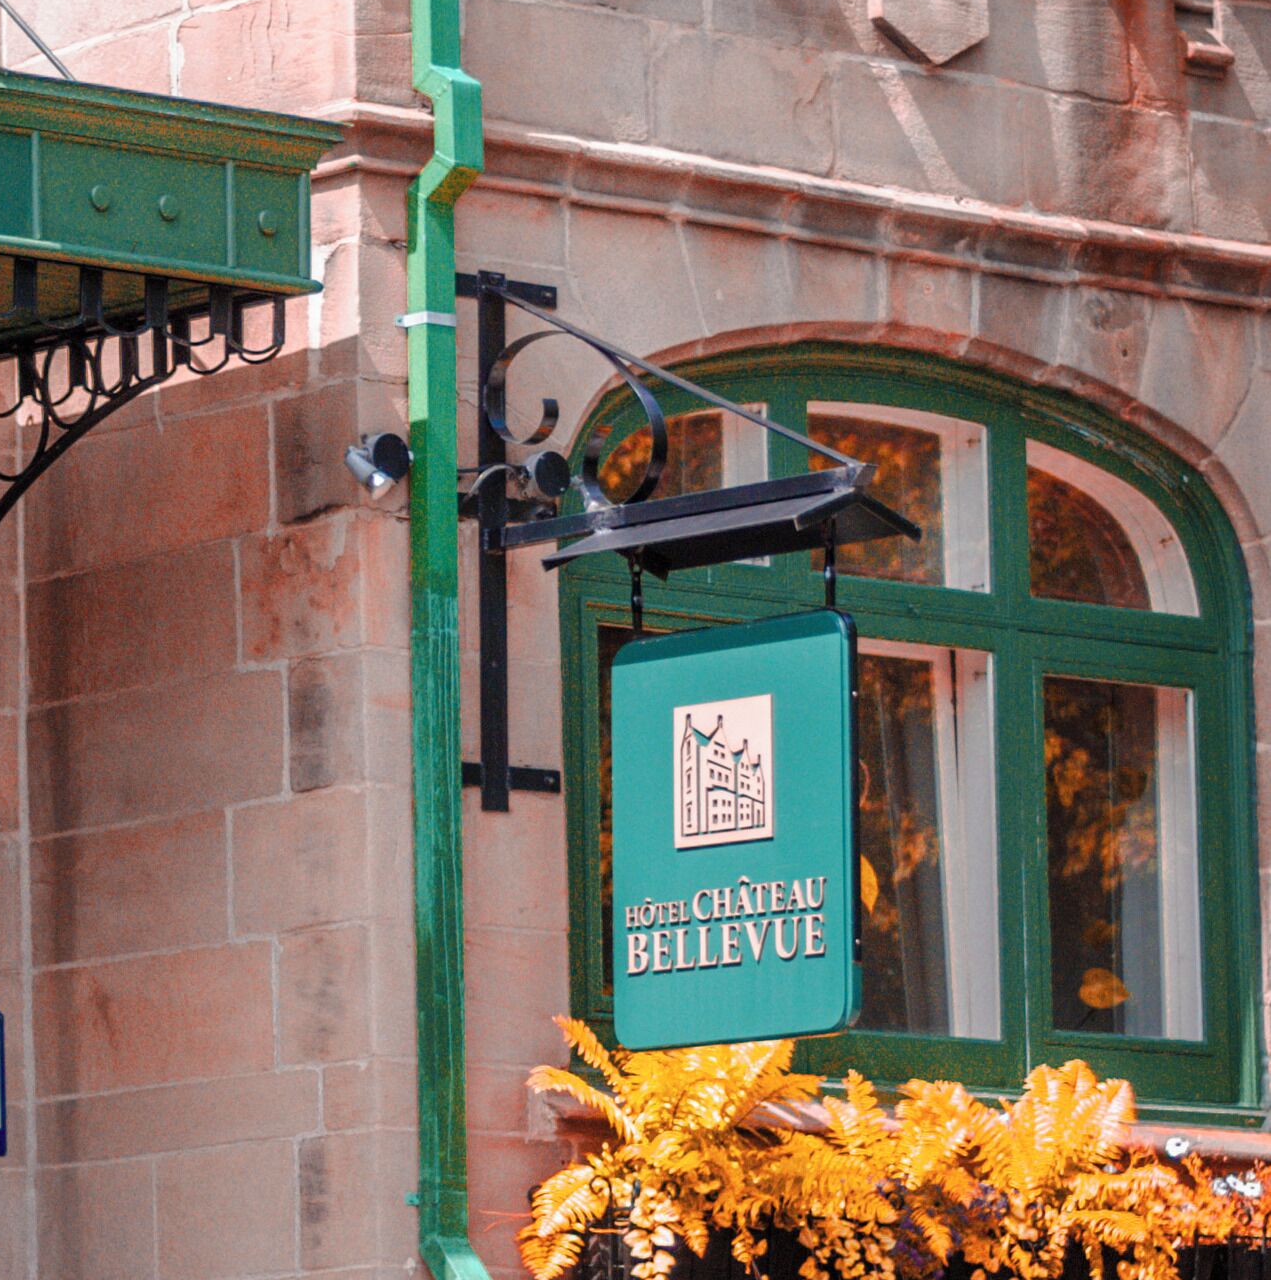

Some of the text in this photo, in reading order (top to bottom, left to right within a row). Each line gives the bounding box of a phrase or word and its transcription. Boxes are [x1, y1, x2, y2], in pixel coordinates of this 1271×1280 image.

[625, 875, 827, 929] HÔTEL CHÂTEAU
[626, 913, 826, 976] BELLEVUE
